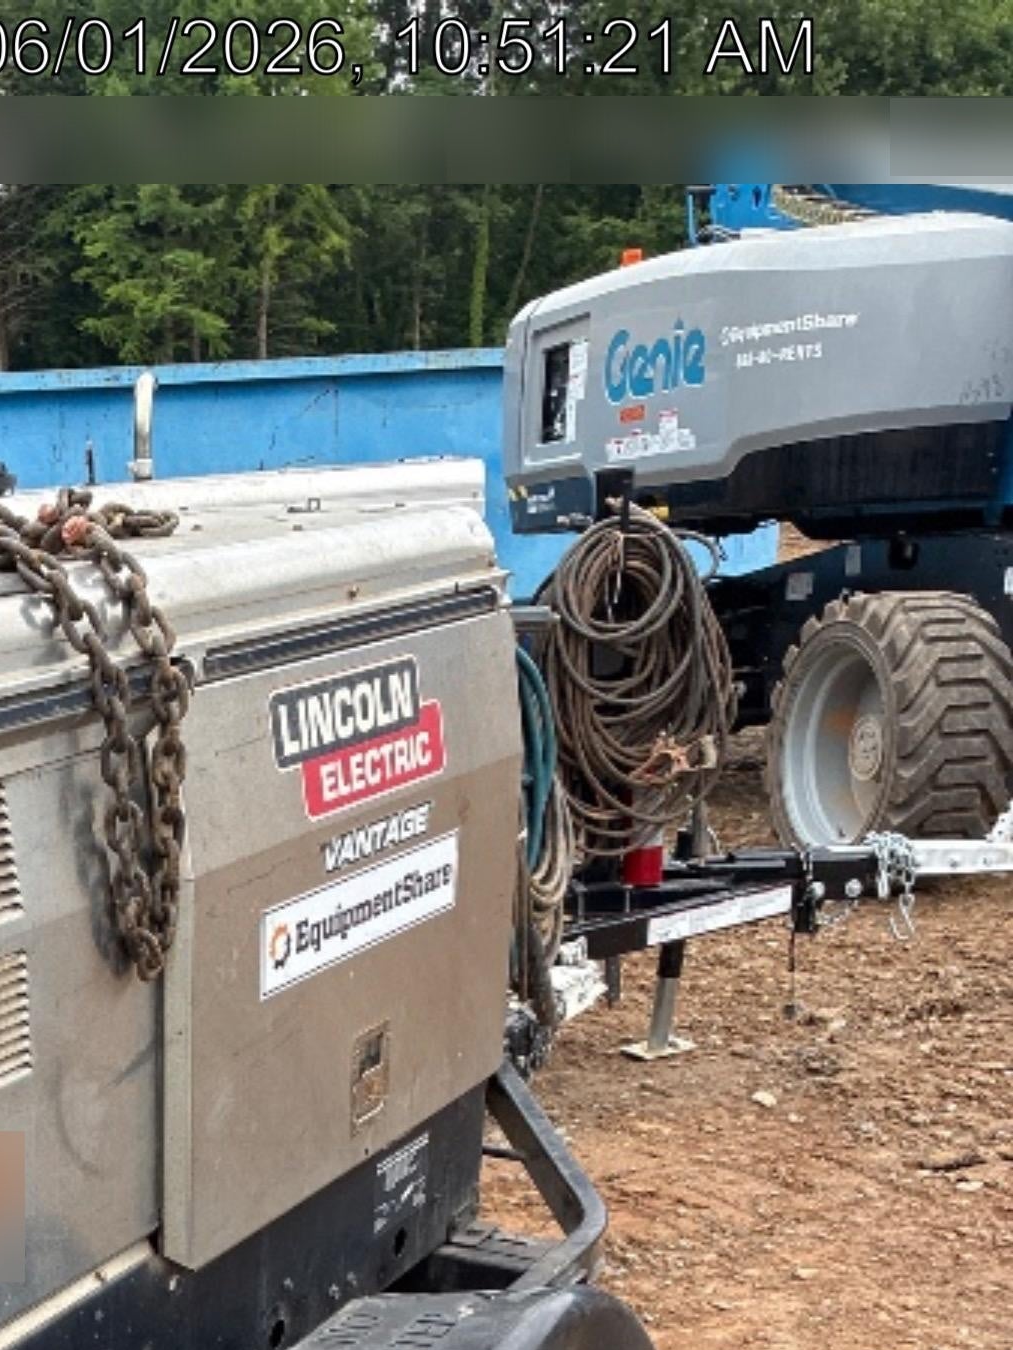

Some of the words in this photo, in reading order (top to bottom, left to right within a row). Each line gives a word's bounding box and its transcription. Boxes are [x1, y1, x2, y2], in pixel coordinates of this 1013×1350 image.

[605, 312, 706, 405] Genie
[278, 670, 415, 757] LINCOLN
[320, 731, 433, 801] ELECTRIC
[323, 803, 431, 872] VANTAGE
[295, 862, 452, 954] EquipmentShare
